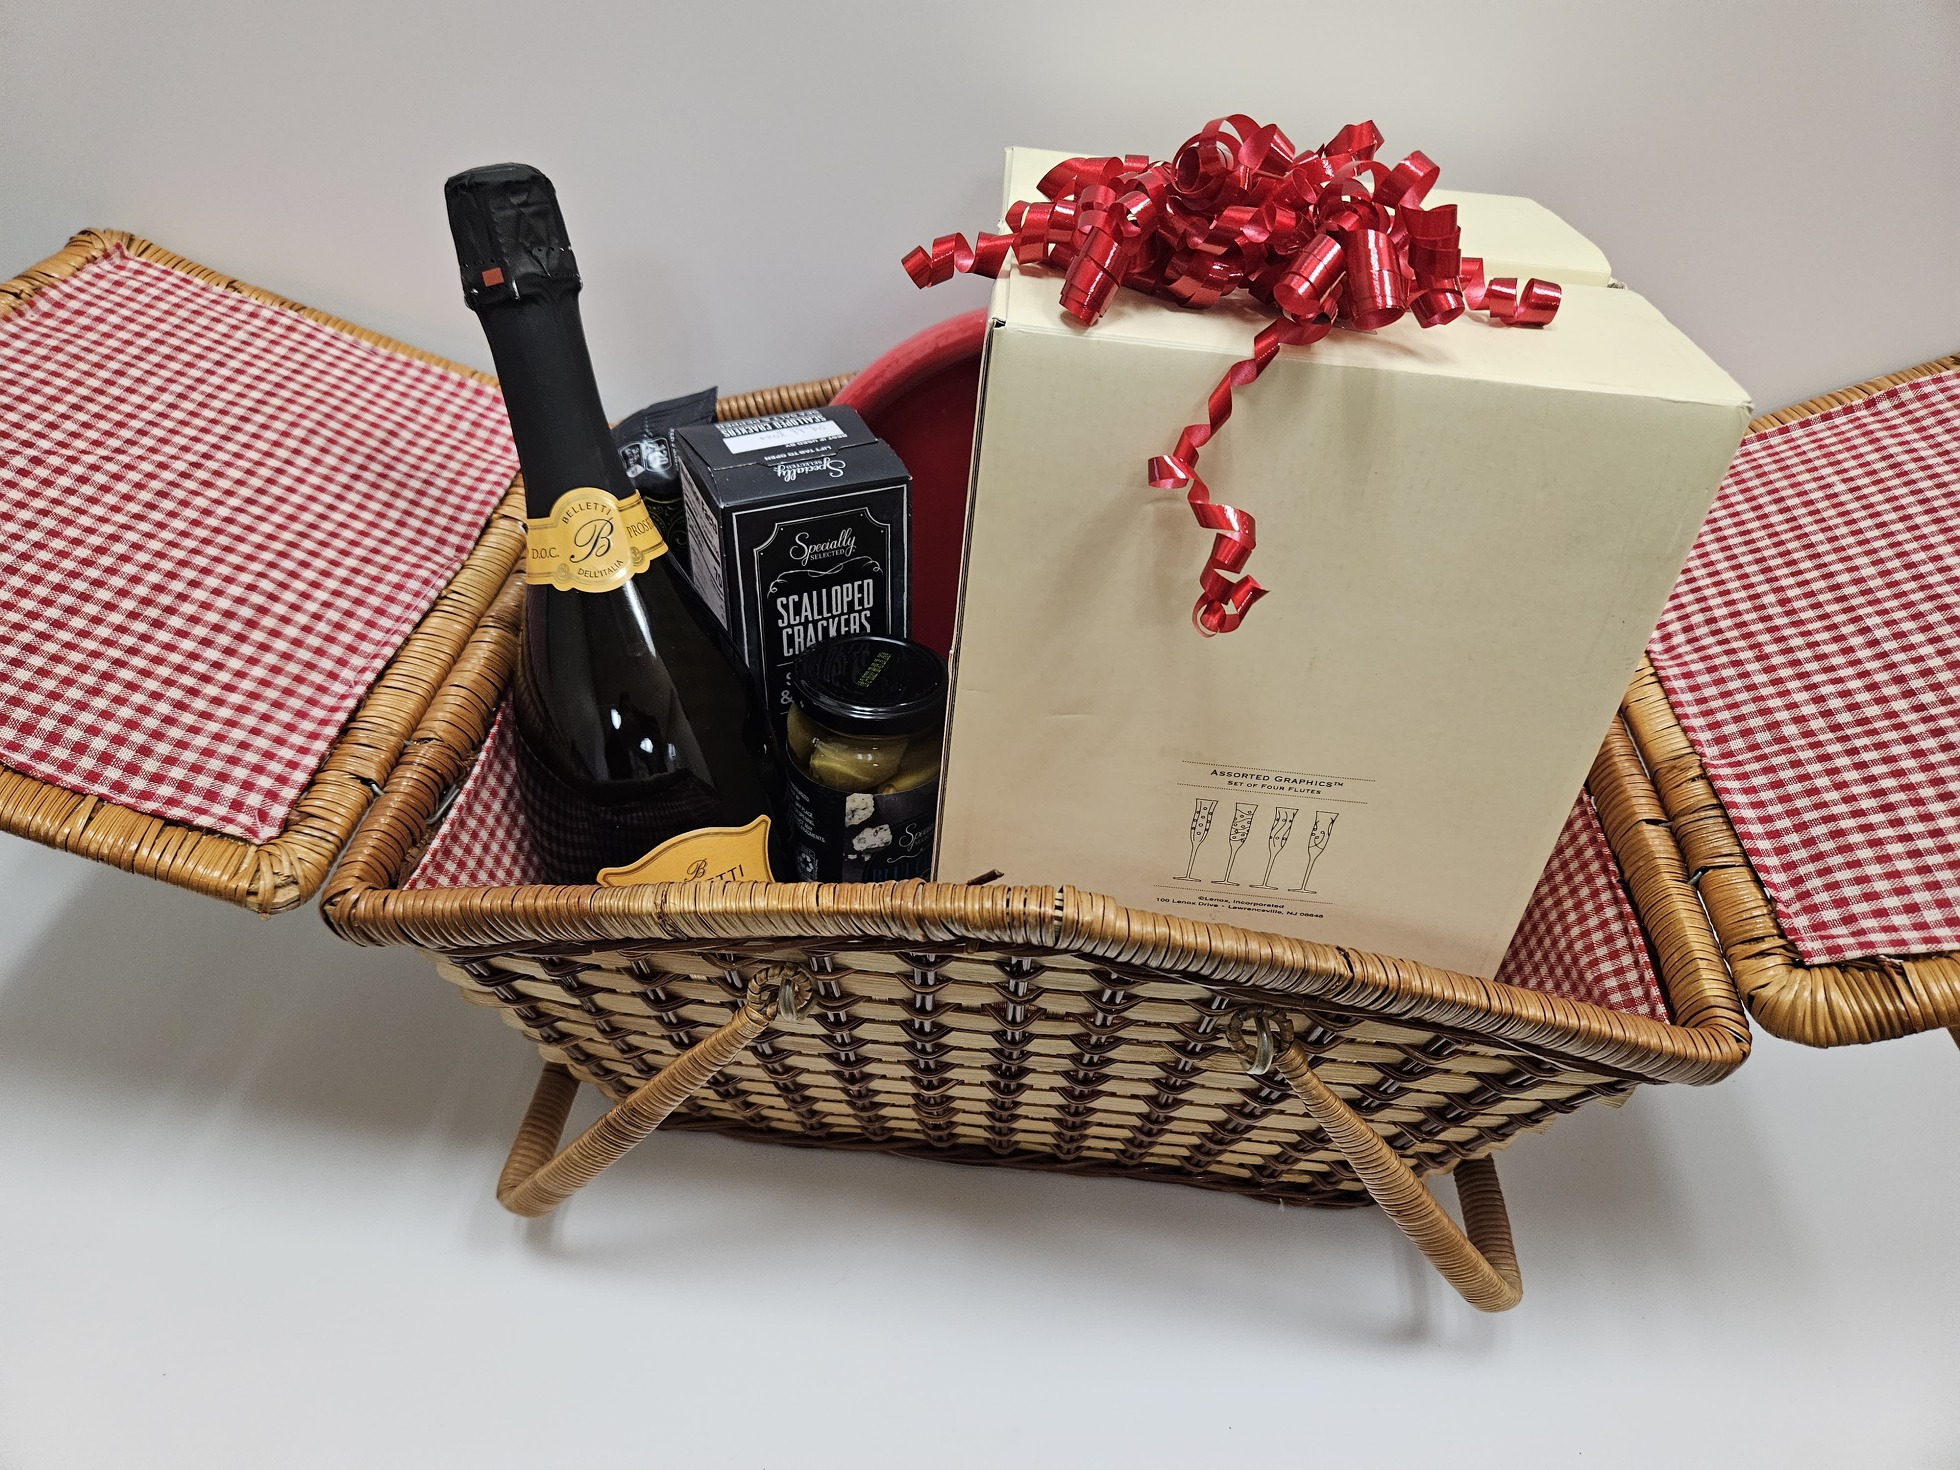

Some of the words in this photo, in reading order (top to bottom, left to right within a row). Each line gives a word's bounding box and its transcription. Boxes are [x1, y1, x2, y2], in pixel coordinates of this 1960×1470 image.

[777, 456, 846, 482] Specially
[561, 501, 612, 525] BELLETTI
[532, 547, 560, 560] D.O.C.
[789, 527, 857, 567] Specially
[810, 549, 845, 561] SELECTED
[577, 559, 624, 579] DELL'ITALIA
[776, 578, 874, 628] SCALLOPED
[782, 610, 871, 657] CRACKERS
[1210, 769, 1270, 782] ASSORTED
[1233, 899, 1285, 909] Incorporated
